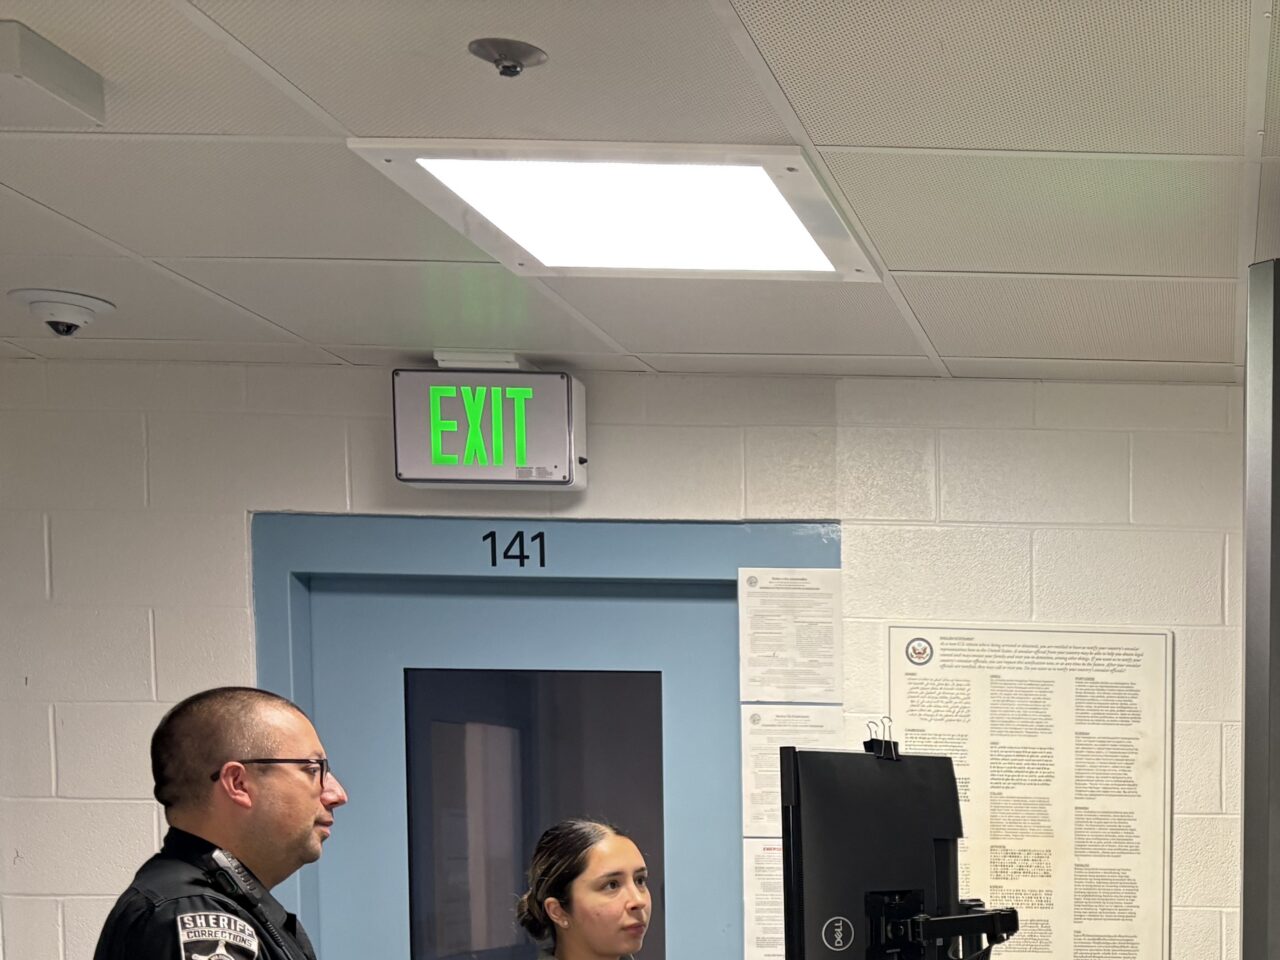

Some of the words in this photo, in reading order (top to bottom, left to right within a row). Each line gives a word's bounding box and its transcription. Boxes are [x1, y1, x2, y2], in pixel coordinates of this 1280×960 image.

[428, 384, 534, 467] EXIT
[481, 530, 547, 568] 141
[182, 914, 255, 939] SHERIFF
[186, 929, 253, 947] CORRECTIONS
[834, 919, 843, 947] DELL
